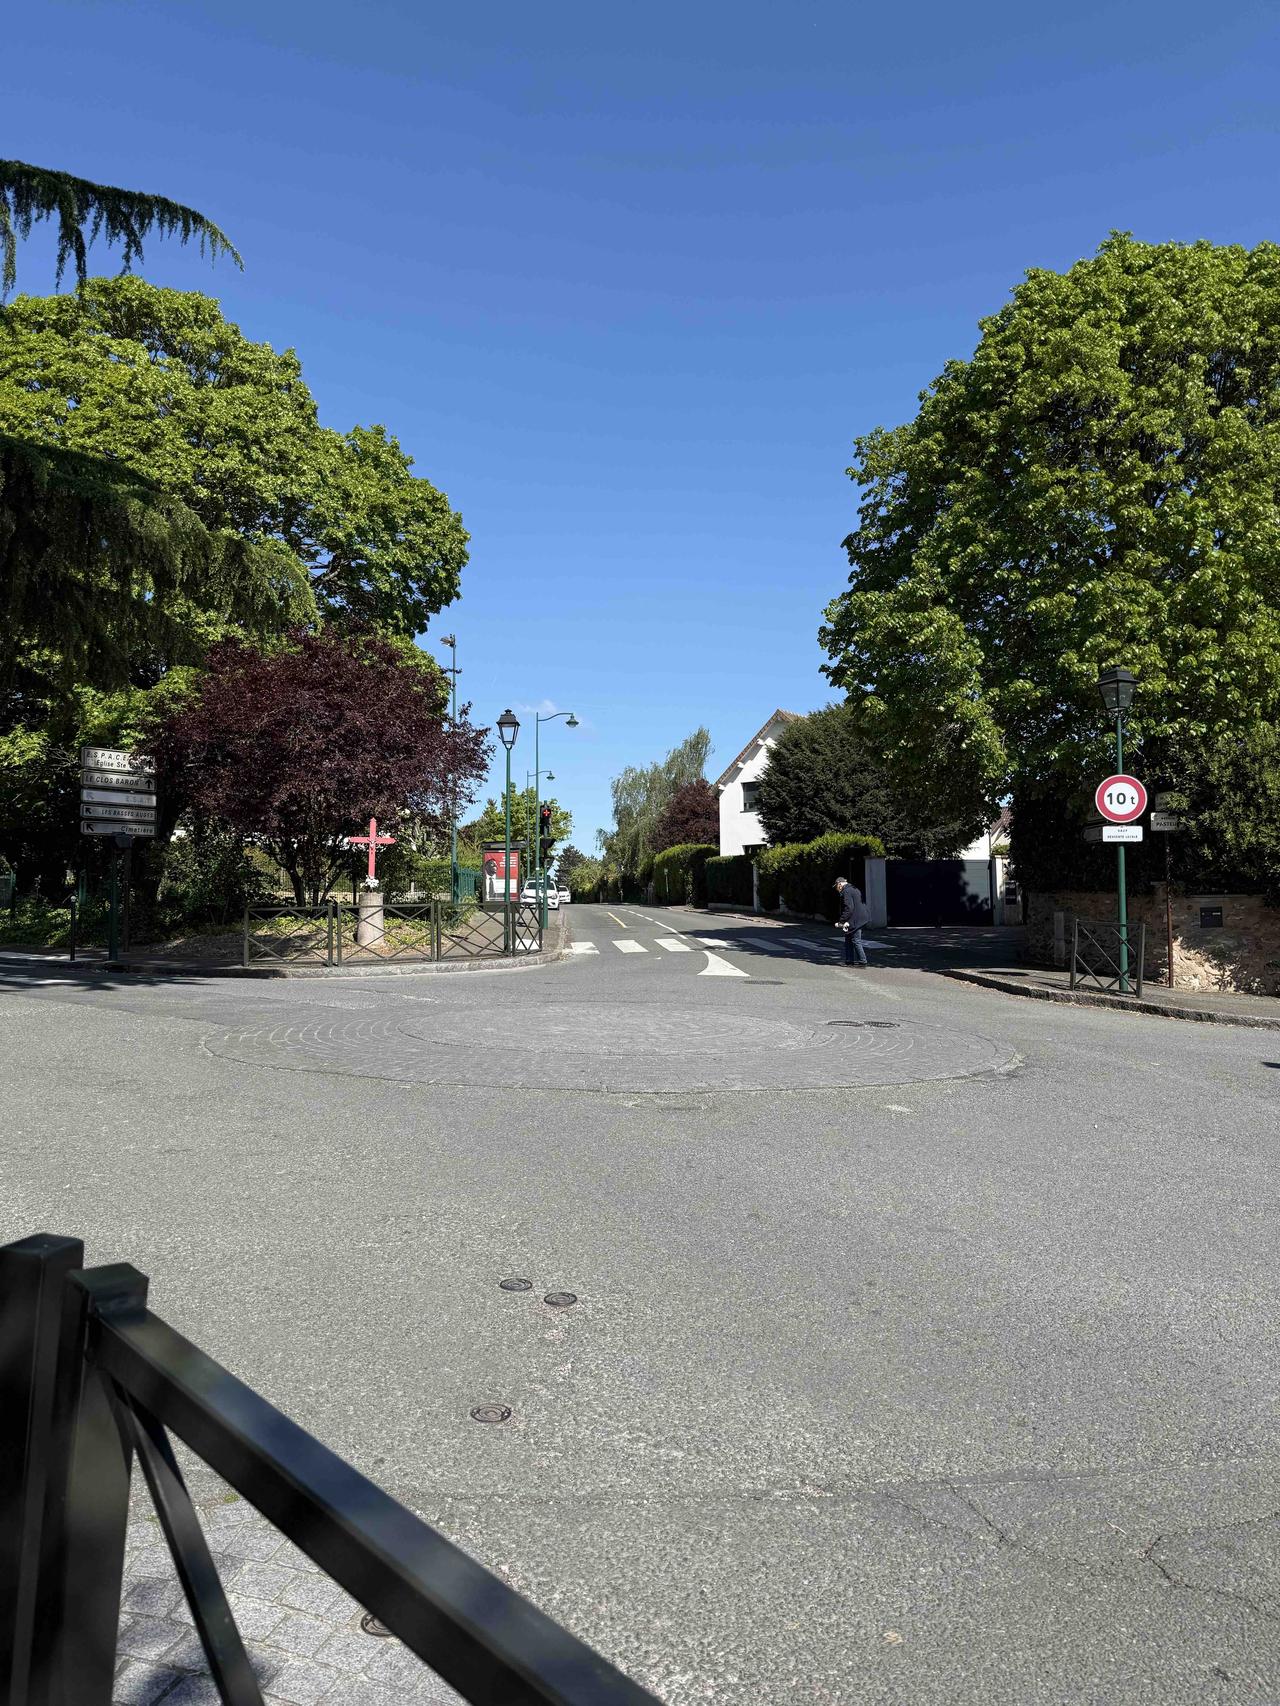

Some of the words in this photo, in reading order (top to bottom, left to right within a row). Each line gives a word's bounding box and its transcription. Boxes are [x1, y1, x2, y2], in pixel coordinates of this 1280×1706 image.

[116, 761, 127, 769] Ste
[85, 775, 94, 783] LE
[95, 776, 114, 784] CLOS
[115, 777, 140, 786] BARON
